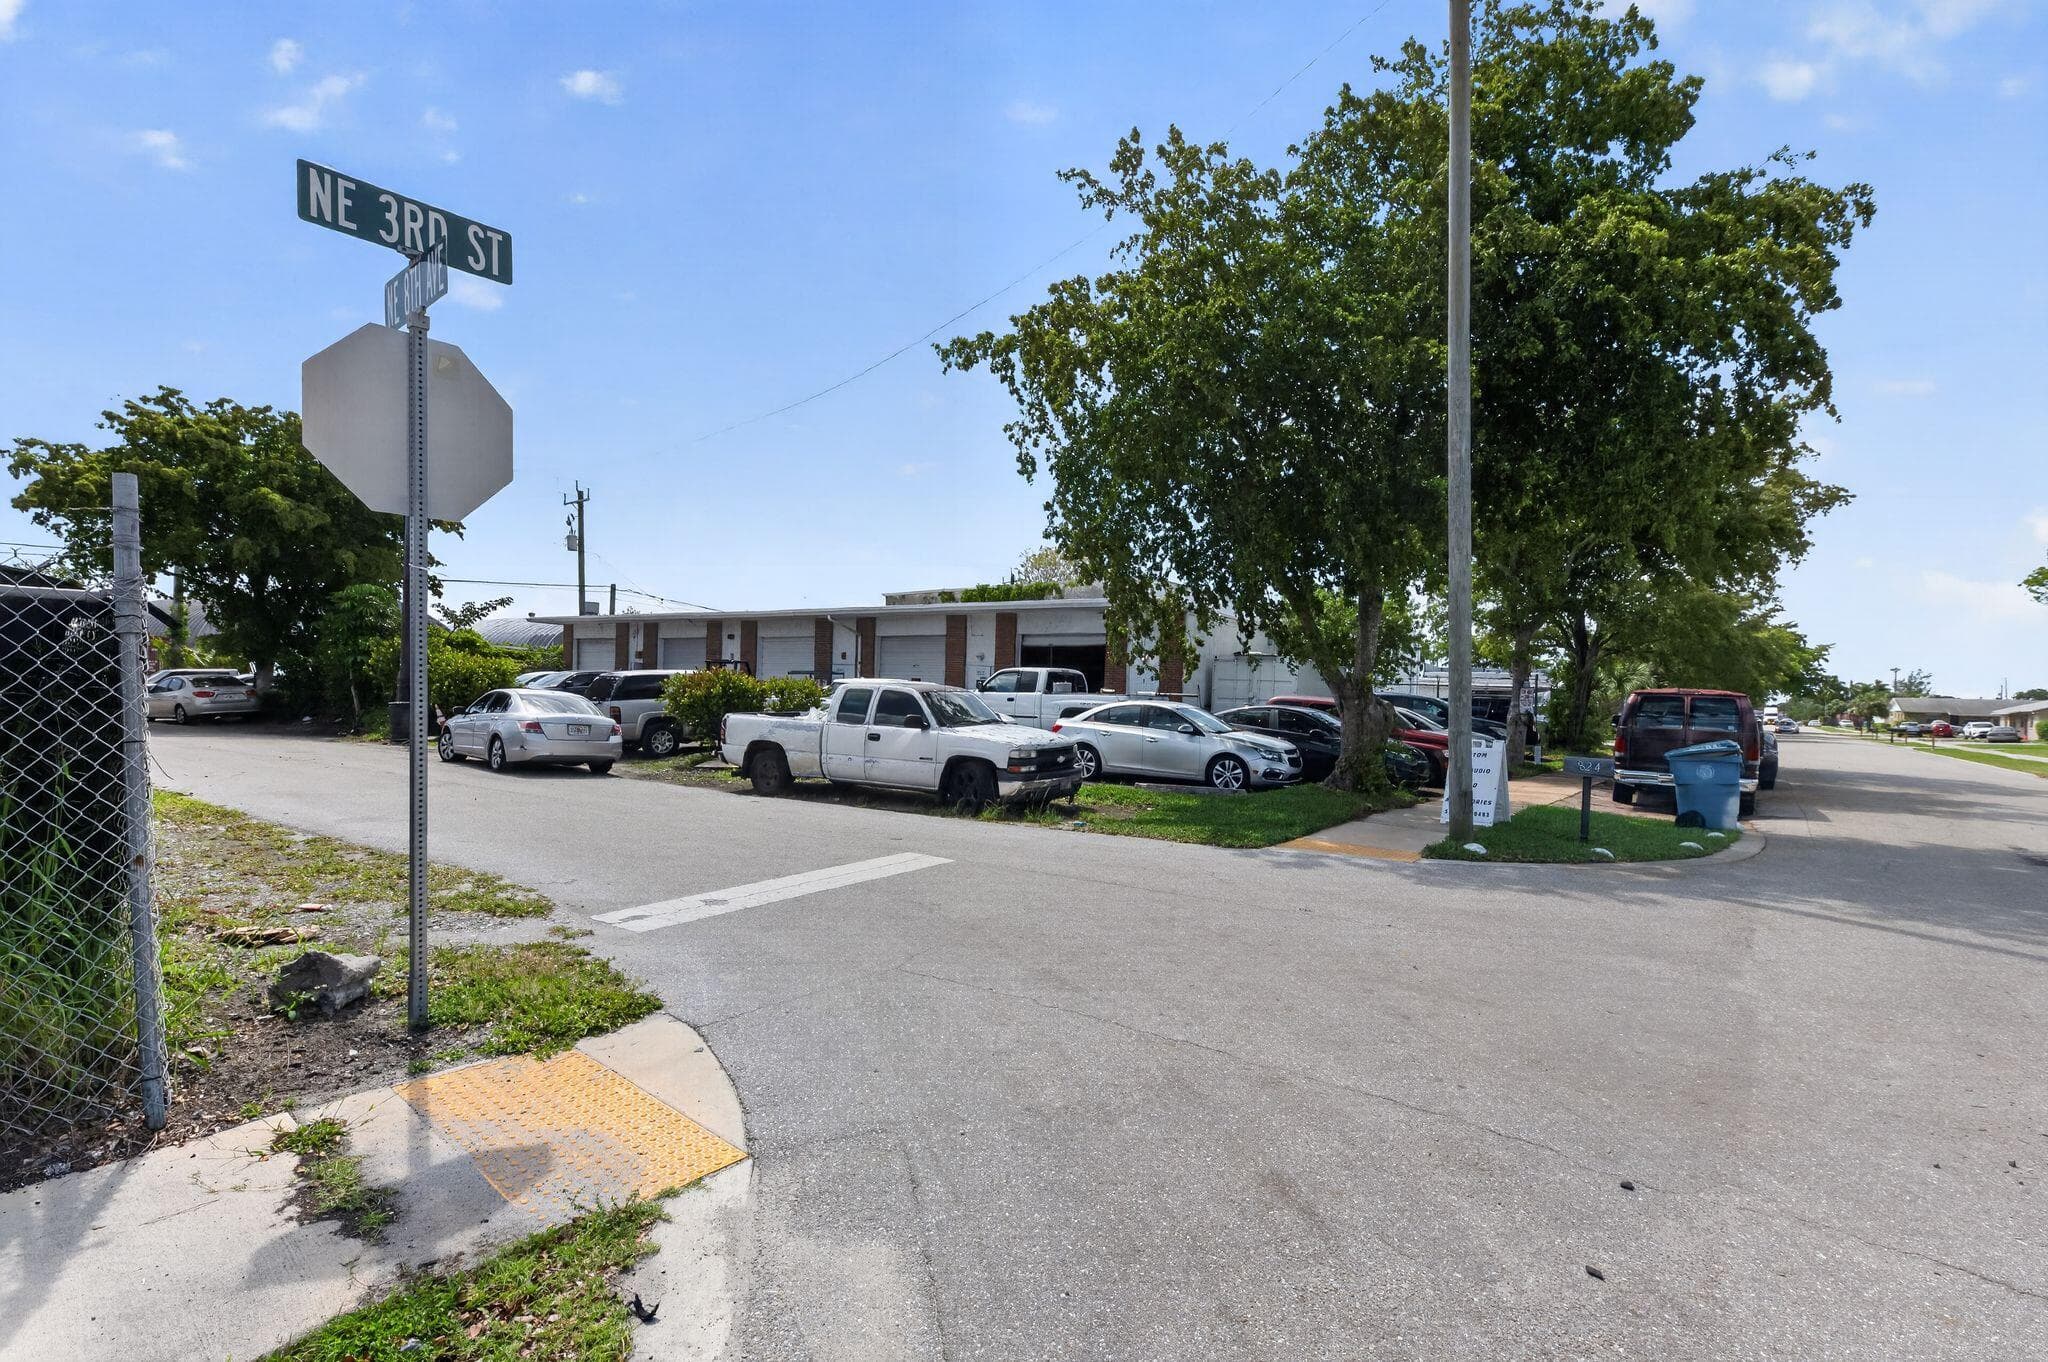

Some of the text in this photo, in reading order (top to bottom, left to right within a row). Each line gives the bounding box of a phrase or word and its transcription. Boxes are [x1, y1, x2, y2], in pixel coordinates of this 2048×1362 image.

[309, 167, 503, 276] NE 3RD ST
[387, 243, 444, 328] NE 8TH AVE
